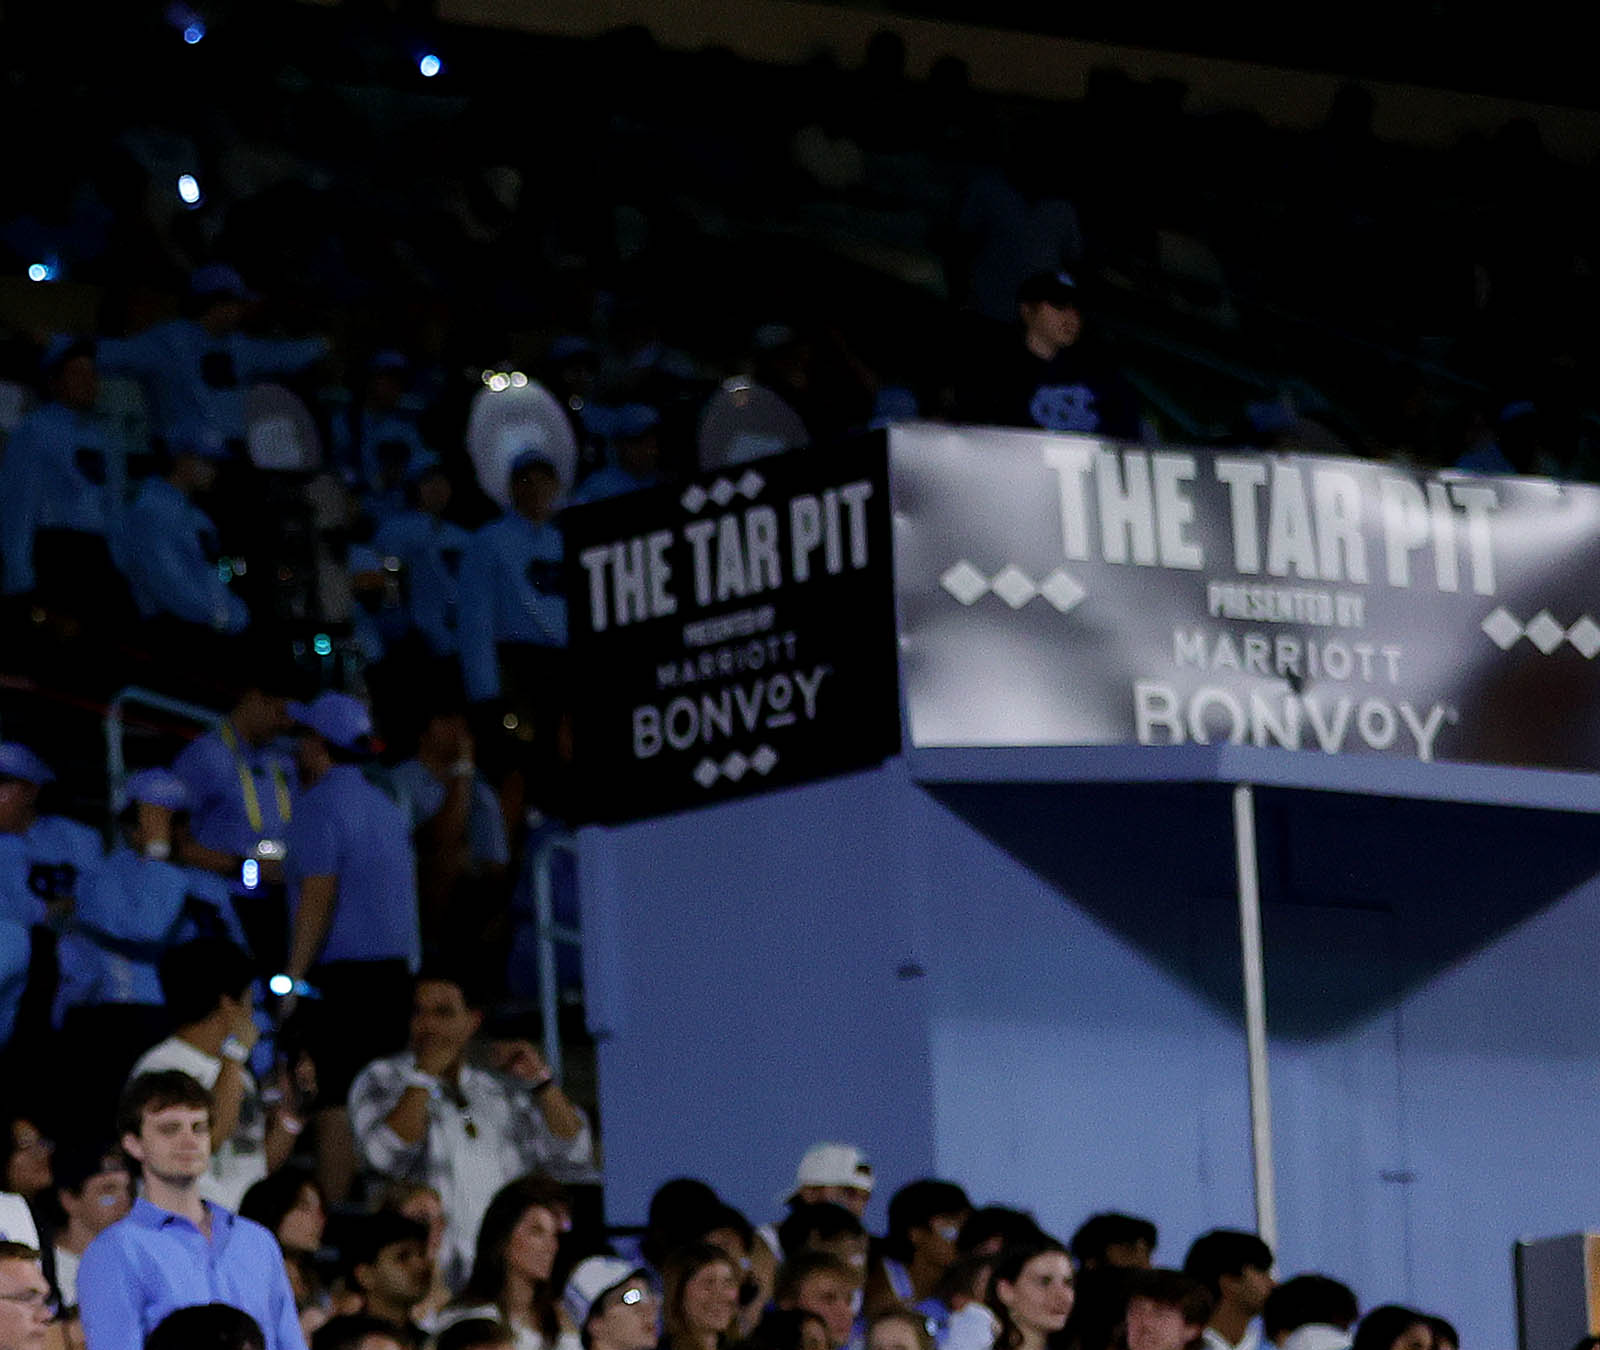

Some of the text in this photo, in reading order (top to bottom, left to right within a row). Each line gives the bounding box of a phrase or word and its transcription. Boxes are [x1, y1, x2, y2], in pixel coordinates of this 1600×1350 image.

[580, 529, 678, 632] THE
[683, 505, 783, 606] TAR
[789, 479, 873, 584] PIT
[1043, 443, 1497, 597] THE TAR PIT
[632, 664, 827, 759] BONVOY
[1174, 627, 1400, 684] MARRIOTT
